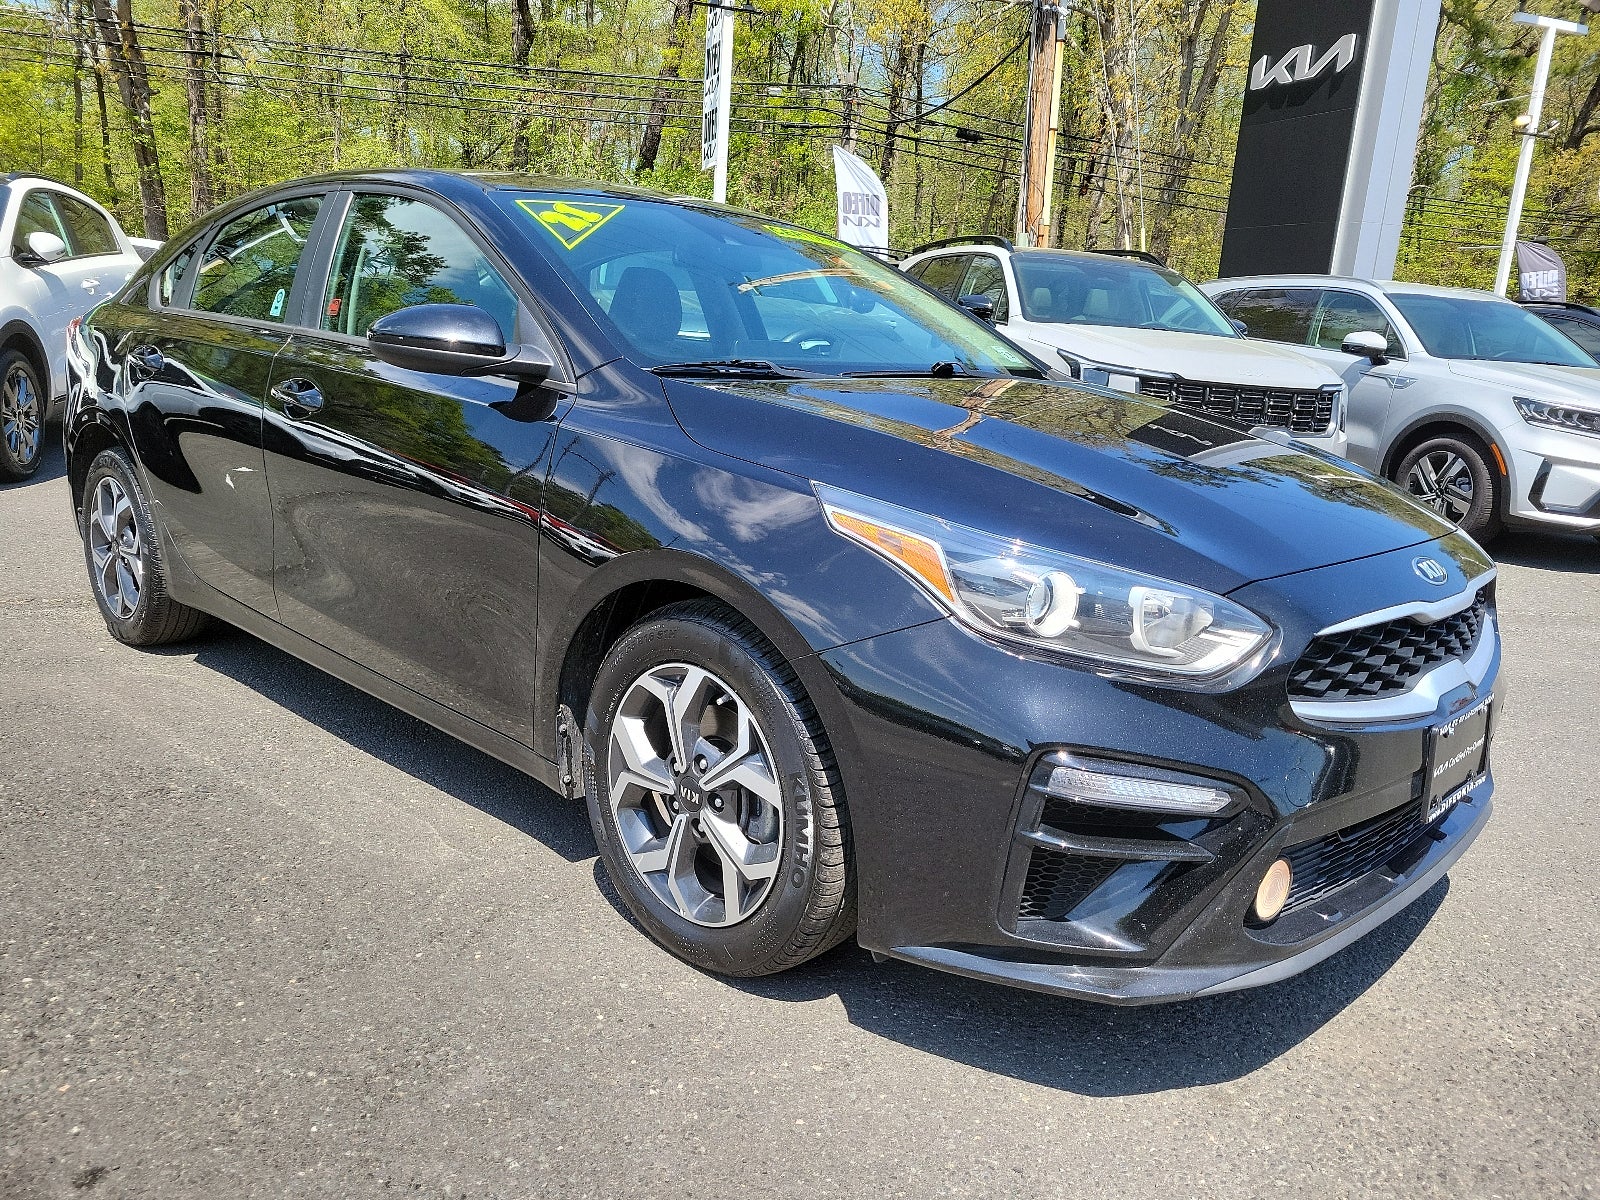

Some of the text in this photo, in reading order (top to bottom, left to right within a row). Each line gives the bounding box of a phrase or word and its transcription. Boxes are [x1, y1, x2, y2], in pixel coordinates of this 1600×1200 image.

[1249, 33, 1357, 91] KIA
[680, 784, 699, 804] KIA
[789, 771, 809, 889] KUMHO
